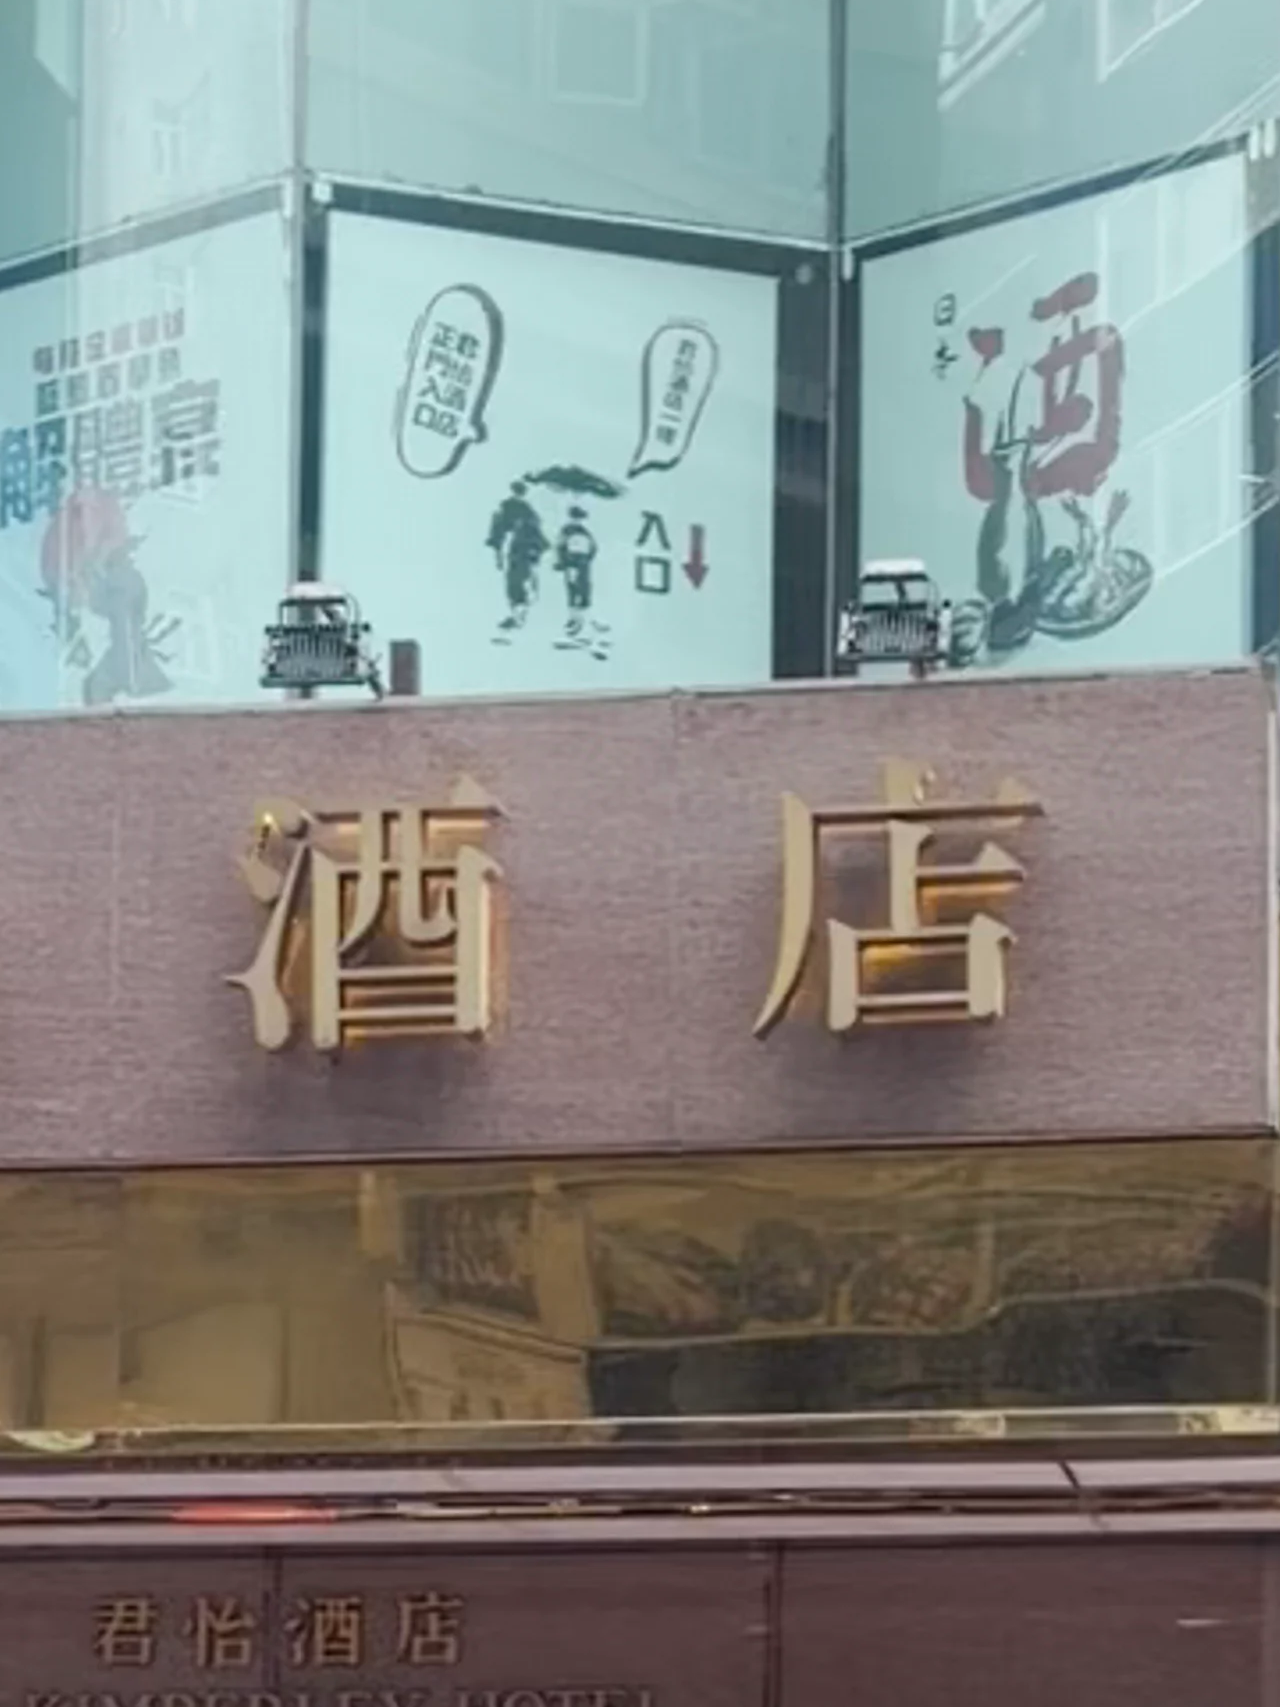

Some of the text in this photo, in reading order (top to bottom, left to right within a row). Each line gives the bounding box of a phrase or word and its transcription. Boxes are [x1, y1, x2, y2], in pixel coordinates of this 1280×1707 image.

[635, 509, 671, 595] 入口
[92, 1590, 468, 1668] 君怡酒店
